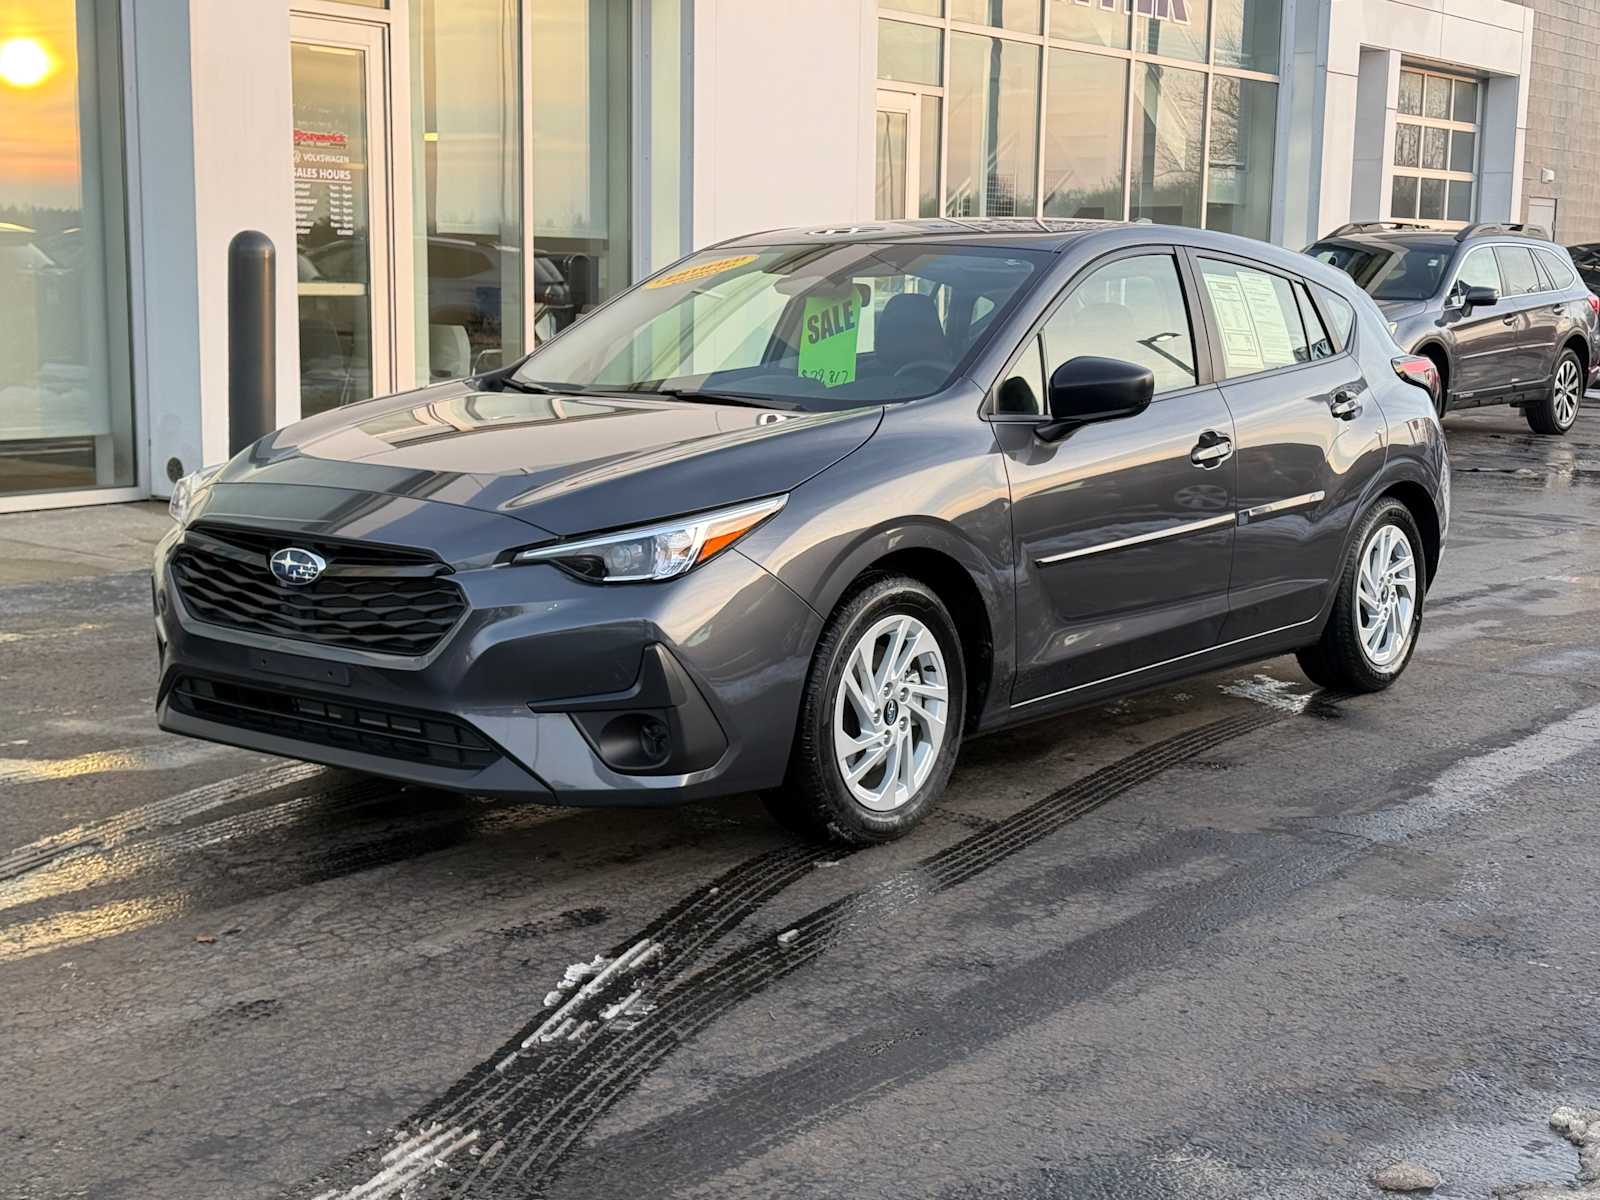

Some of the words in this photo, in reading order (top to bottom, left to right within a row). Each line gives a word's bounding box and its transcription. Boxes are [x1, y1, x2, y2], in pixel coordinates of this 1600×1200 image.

[302, 152, 350, 163] VOLKSWAGEN
[319, 169, 352, 180] HOURS
[807, 300, 855, 344] SALE
